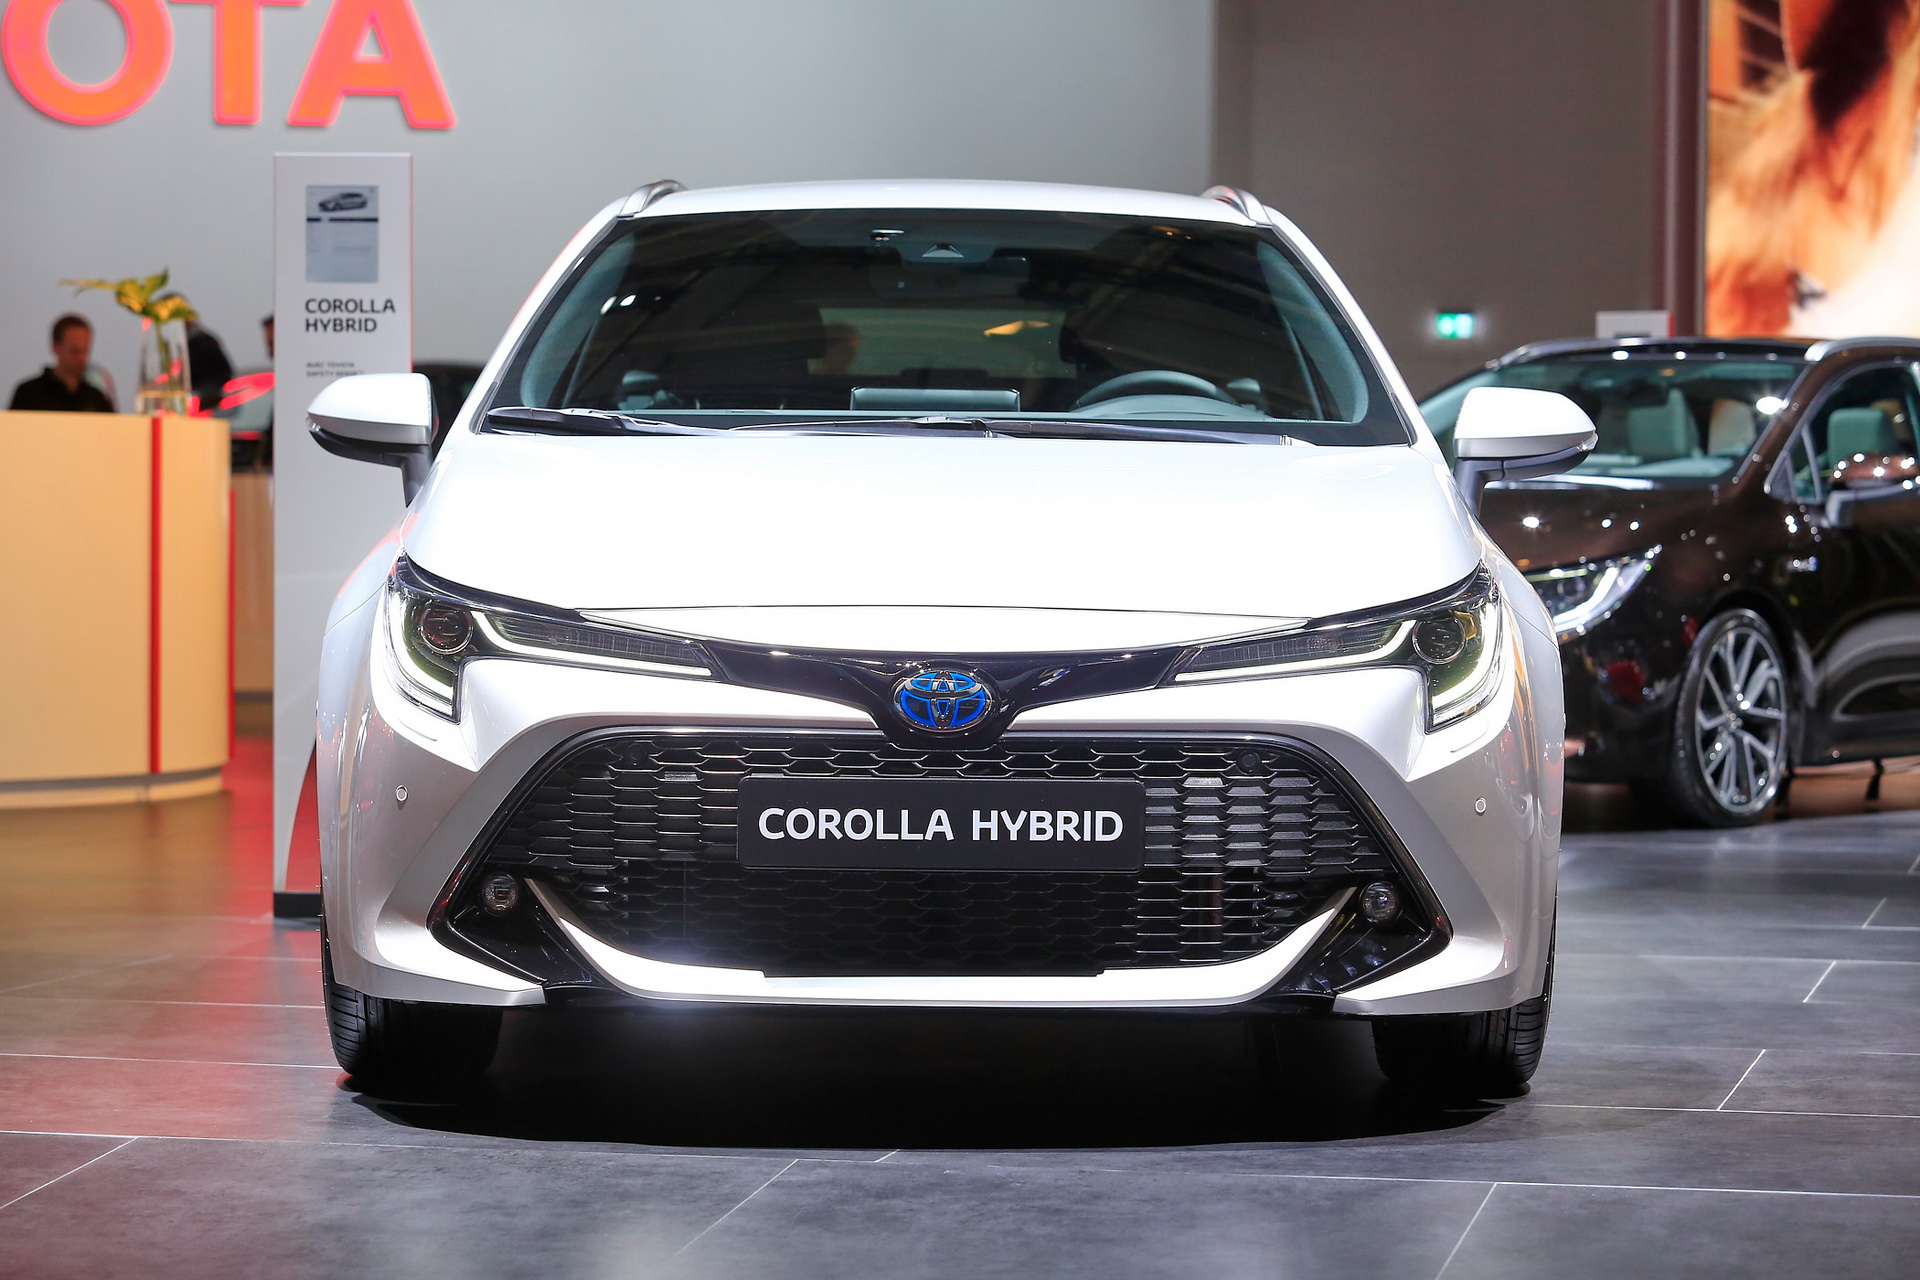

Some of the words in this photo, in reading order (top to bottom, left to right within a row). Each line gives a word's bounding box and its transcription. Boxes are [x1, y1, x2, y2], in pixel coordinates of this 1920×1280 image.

[305, 298, 395, 314] COROLLA
[305, 318, 377, 333] HYBRID
[758, 807, 955, 842] COROLLA
[971, 809, 1124, 842] HYBRID
